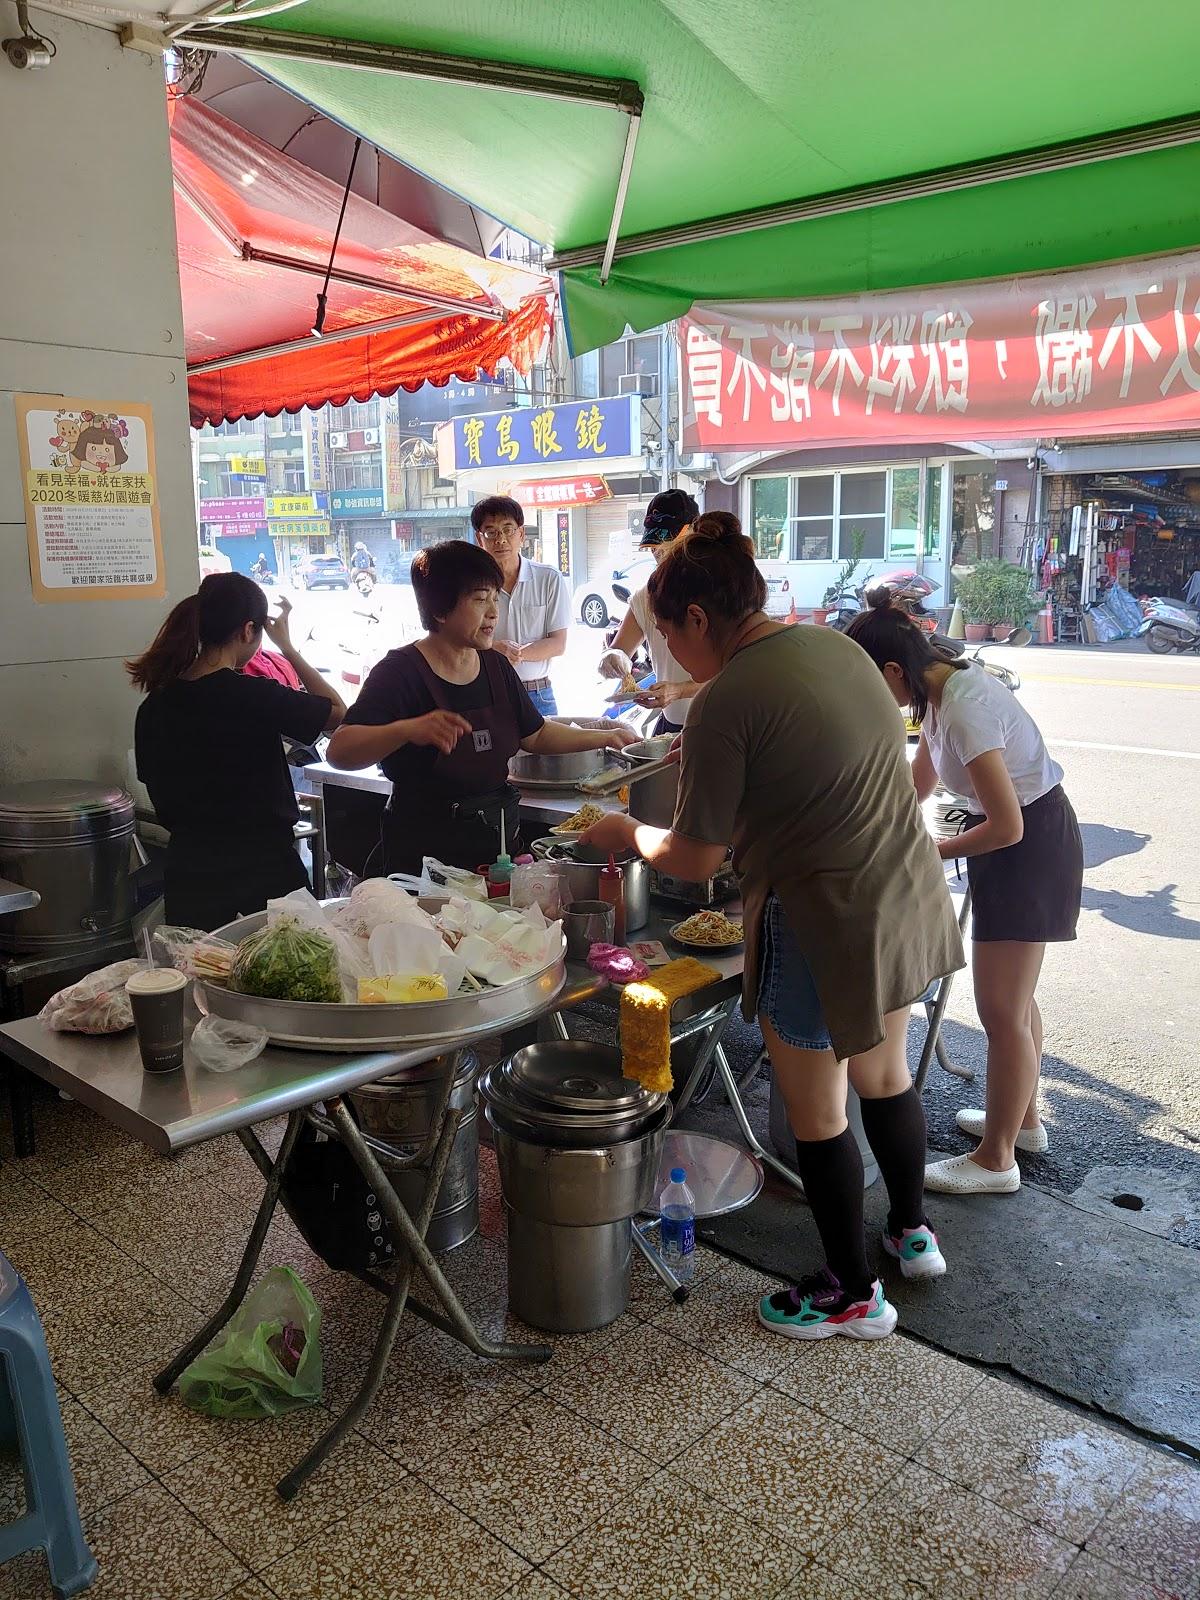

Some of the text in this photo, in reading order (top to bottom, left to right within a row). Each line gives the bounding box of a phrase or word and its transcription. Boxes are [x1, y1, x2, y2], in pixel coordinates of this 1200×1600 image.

[463, 405, 607, 465] 寶島眼鏡
[36, 473, 146, 489] 看見幸福 就在家扶
